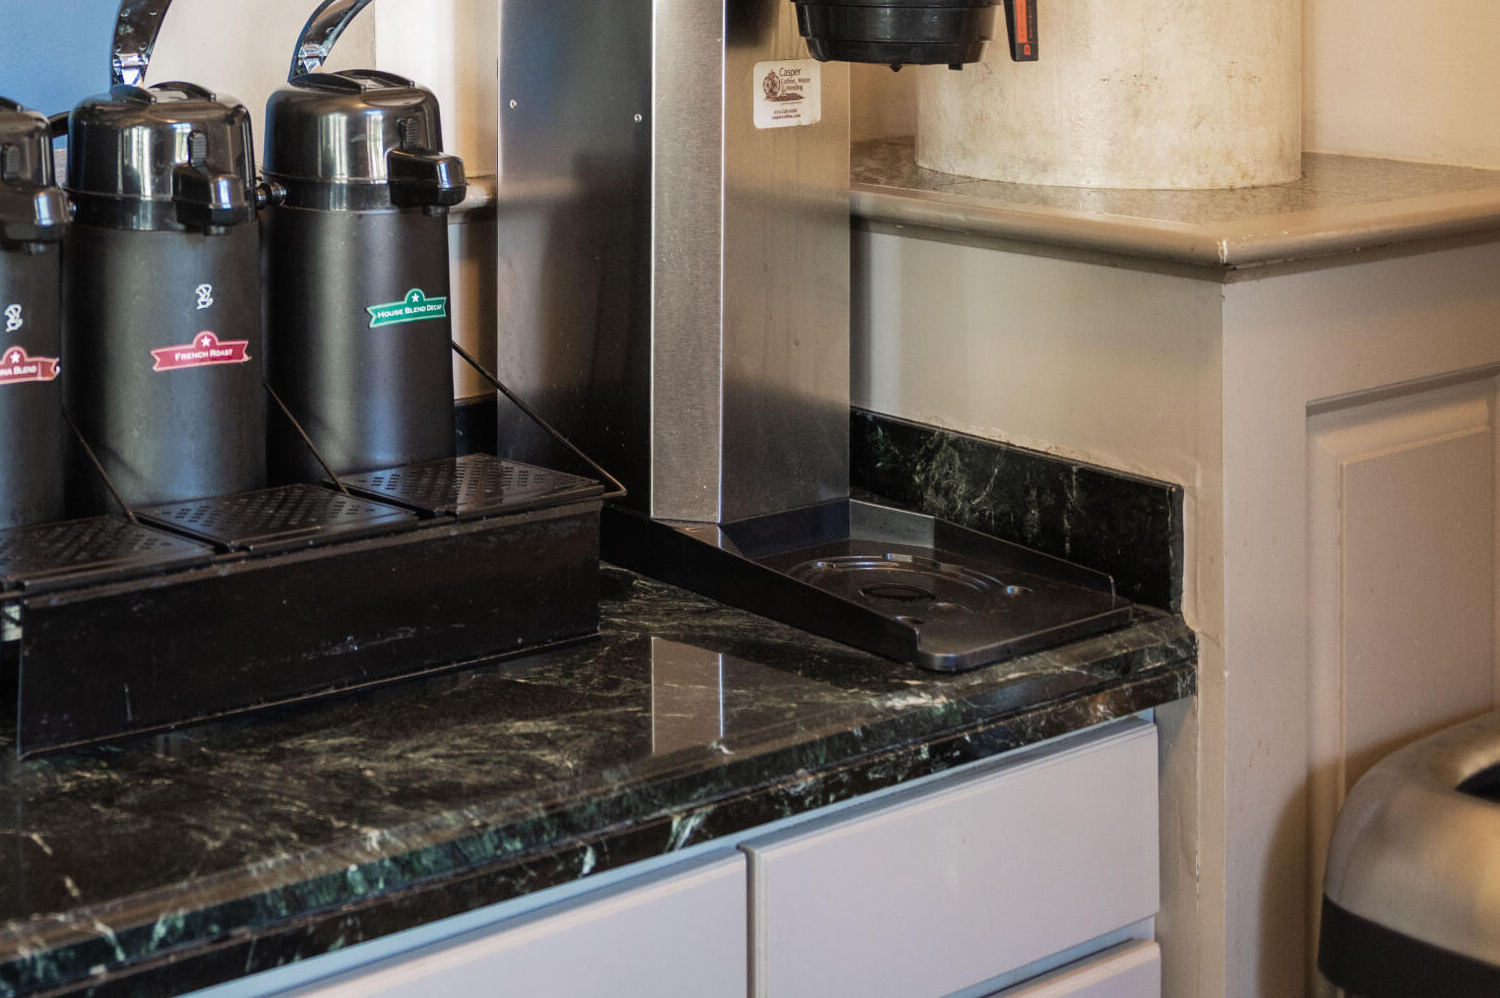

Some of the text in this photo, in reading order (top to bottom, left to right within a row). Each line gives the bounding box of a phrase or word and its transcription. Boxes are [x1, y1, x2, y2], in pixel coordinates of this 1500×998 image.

[779, 67, 802, 78] Casper
[377, 308, 404, 318] HOUSE
[404, 305, 426, 314] BLEND
[174, 348, 234, 361] FRENCH ROAST
